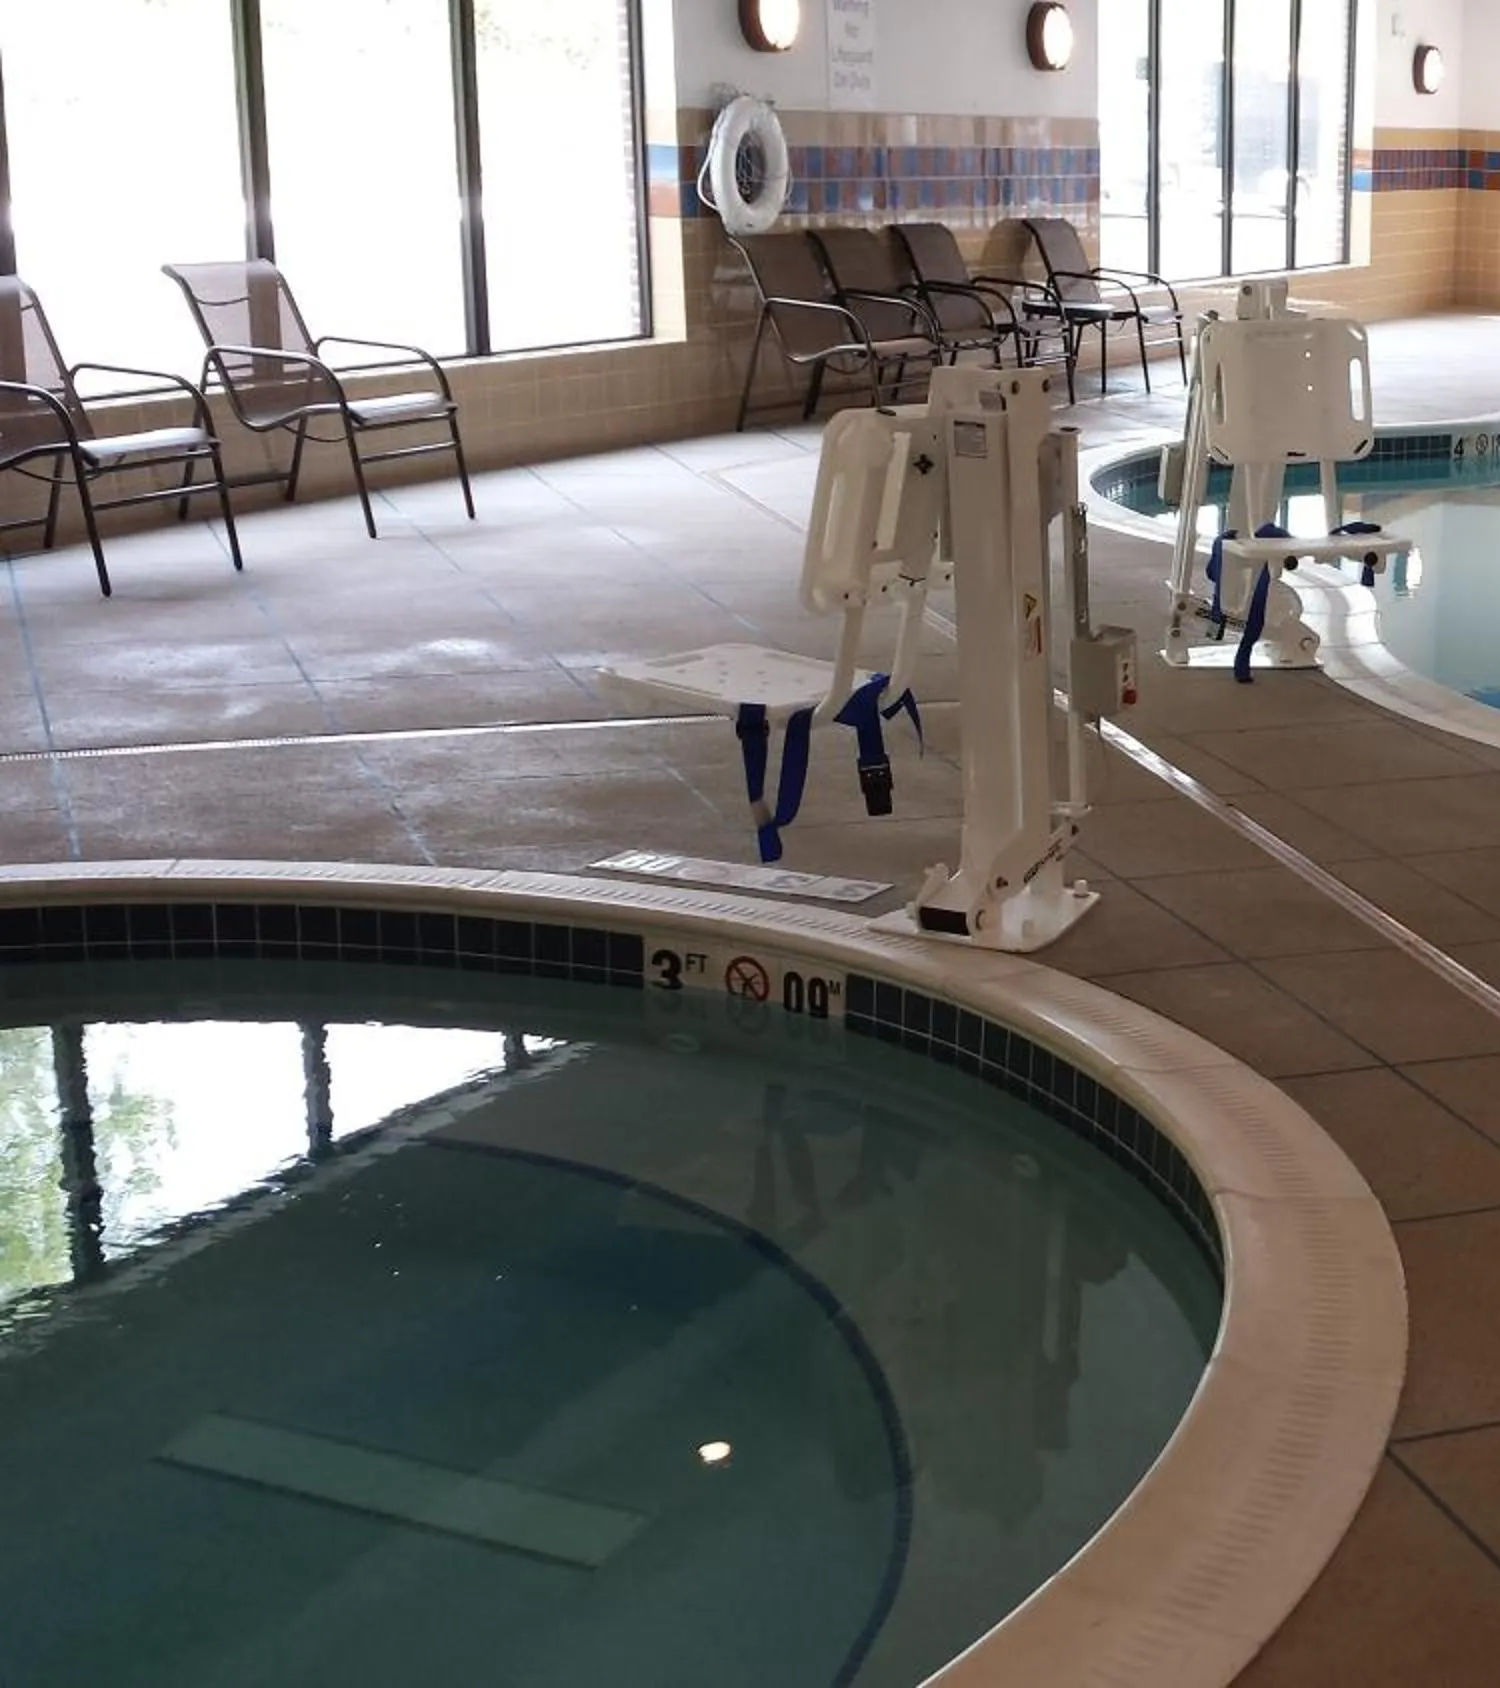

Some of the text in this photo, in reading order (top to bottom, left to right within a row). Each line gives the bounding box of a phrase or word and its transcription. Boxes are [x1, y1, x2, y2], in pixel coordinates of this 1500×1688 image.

[1453, 436, 1464, 455] 4
[651, 949, 709, 990] 3 FT
